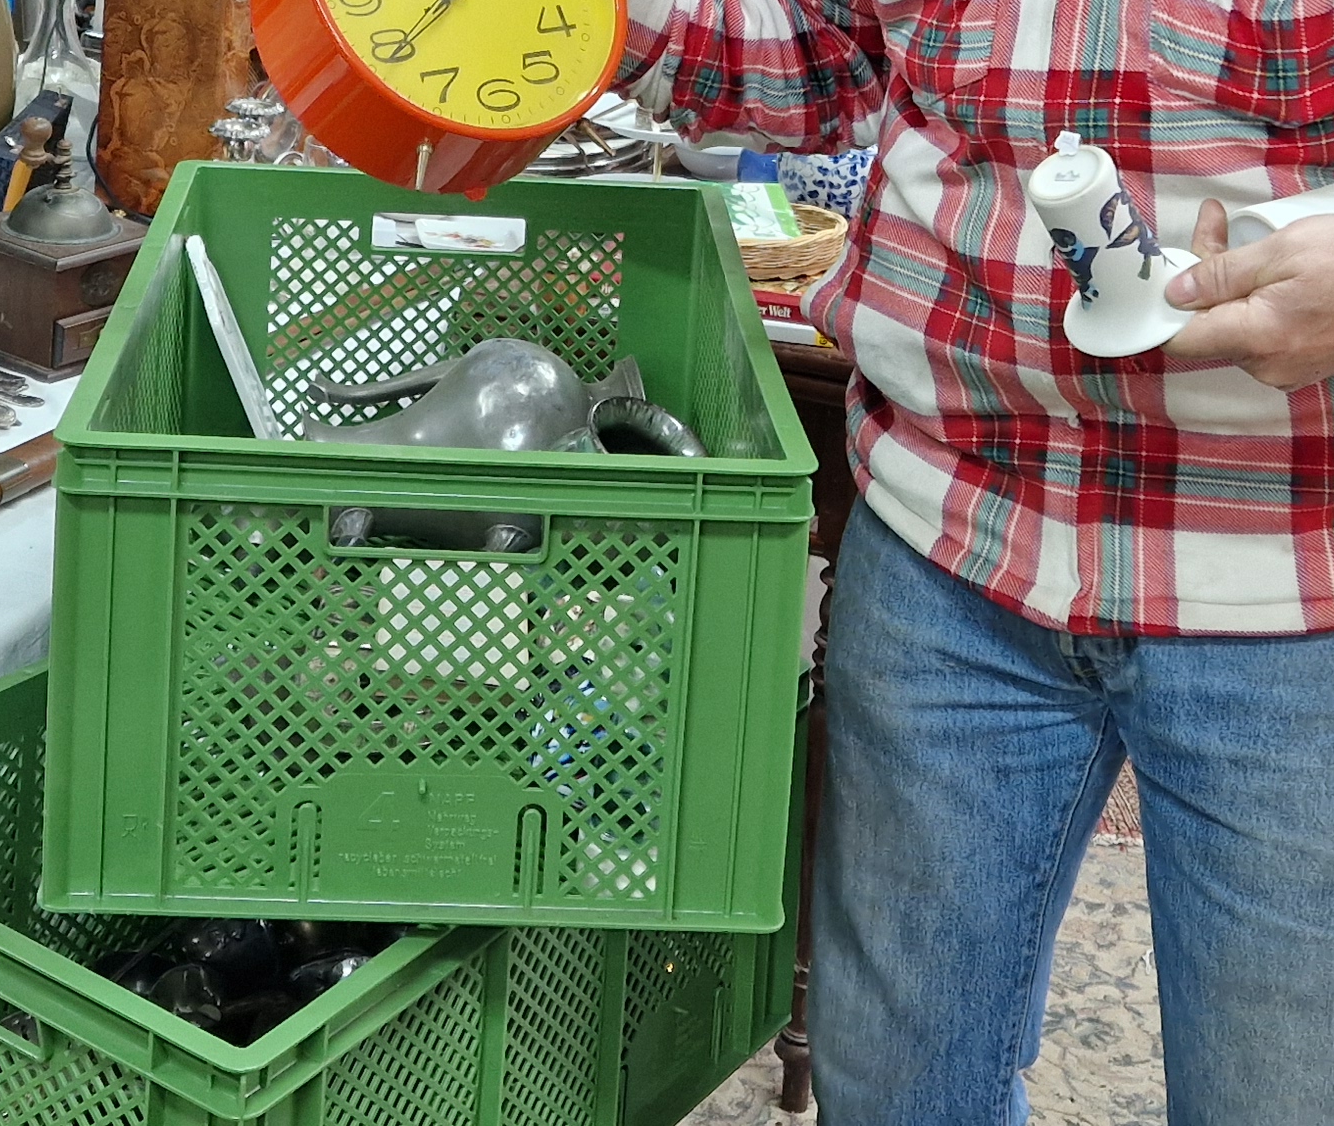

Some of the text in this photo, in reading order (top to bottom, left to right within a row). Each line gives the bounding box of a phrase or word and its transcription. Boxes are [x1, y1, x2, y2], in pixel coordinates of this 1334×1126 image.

[536, 5, 577, 38] 4
[370, 28, 416, 63] 8
[521, 50, 560, 85] 5
[420, 67, 459, 104] 7
[477, 79, 520, 112] 6
[768, 304, 792, 318] Welt
